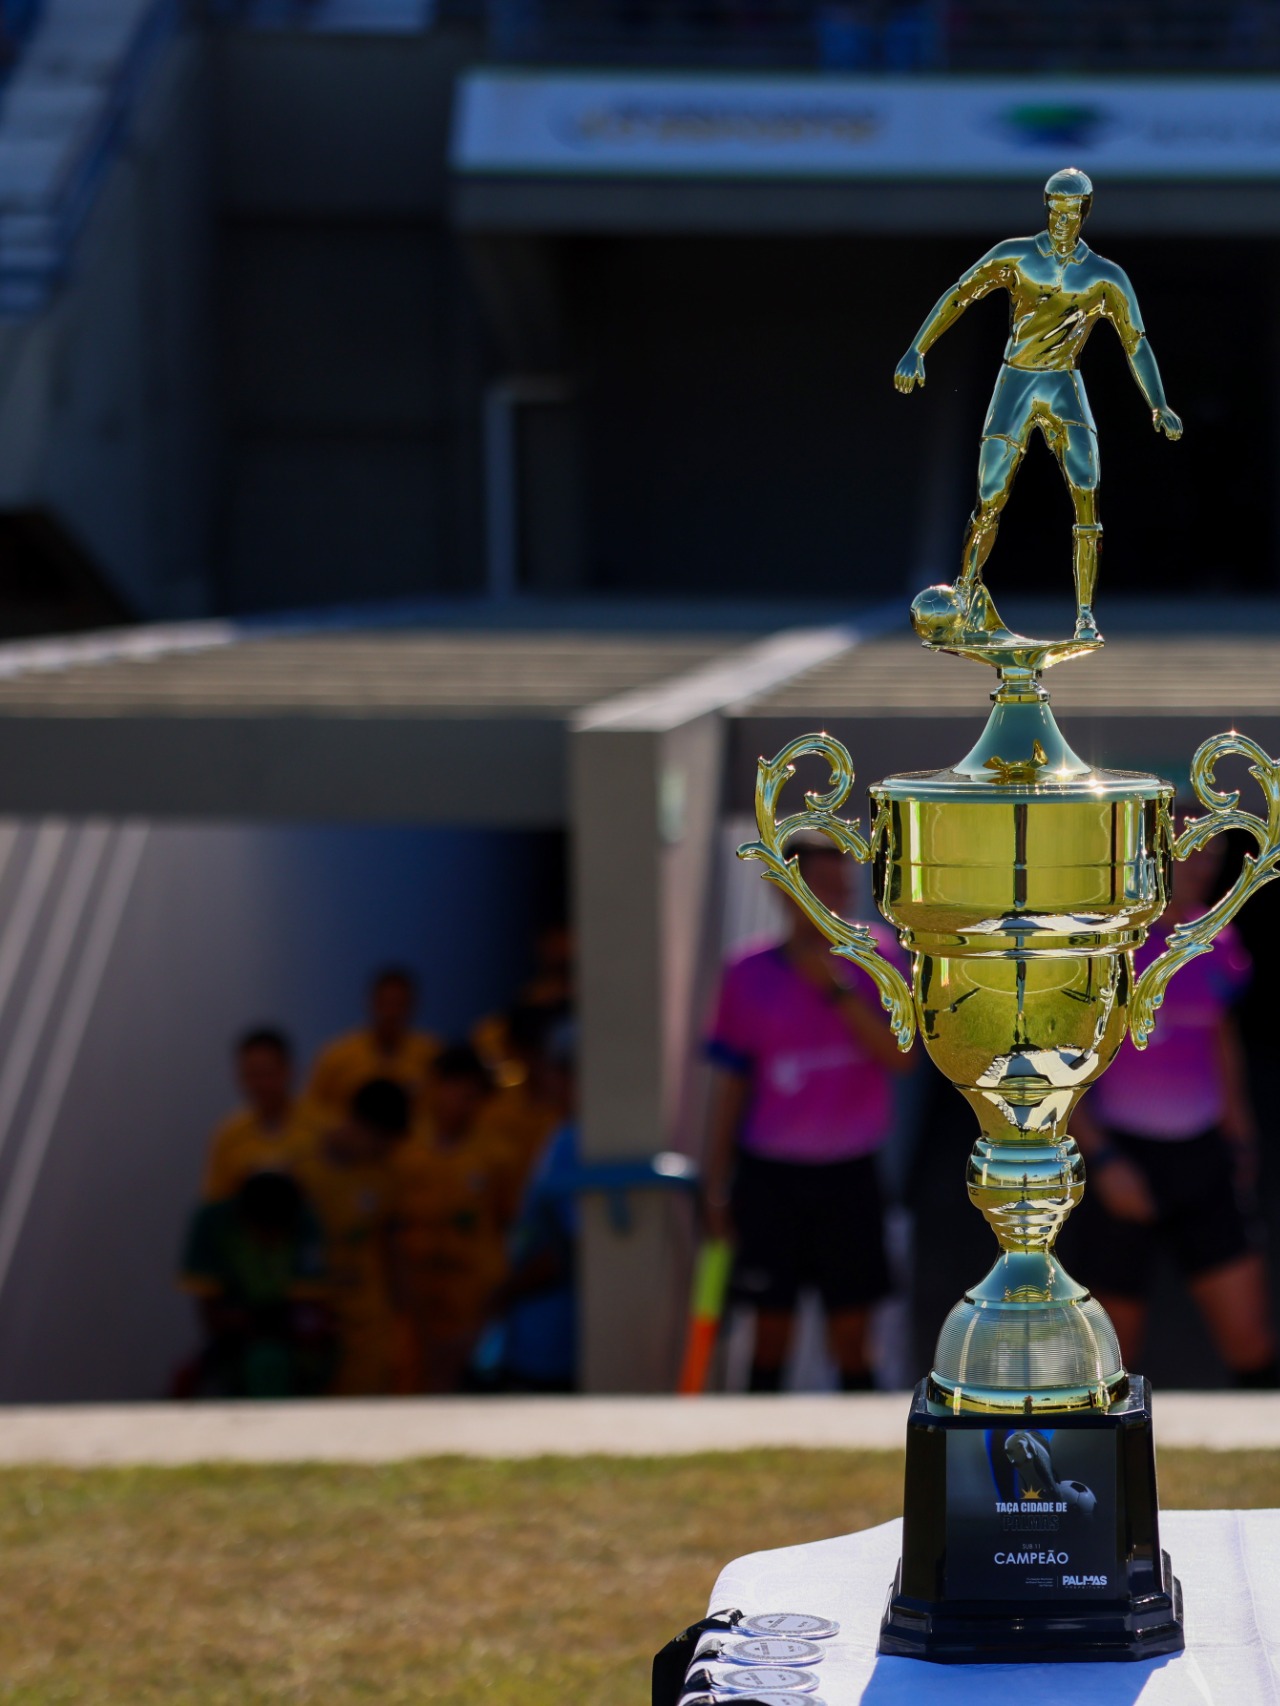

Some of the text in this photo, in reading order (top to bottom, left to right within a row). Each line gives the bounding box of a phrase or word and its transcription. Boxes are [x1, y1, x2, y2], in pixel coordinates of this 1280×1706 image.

[996, 1502, 1067, 1514] TAÇA CIDADE DE
[1003, 1515, 1060, 1532] PALMAS
[994, 1550, 1069, 1564] CAMPEÃO
[1062, 1575, 1108, 1586] PALMAS
